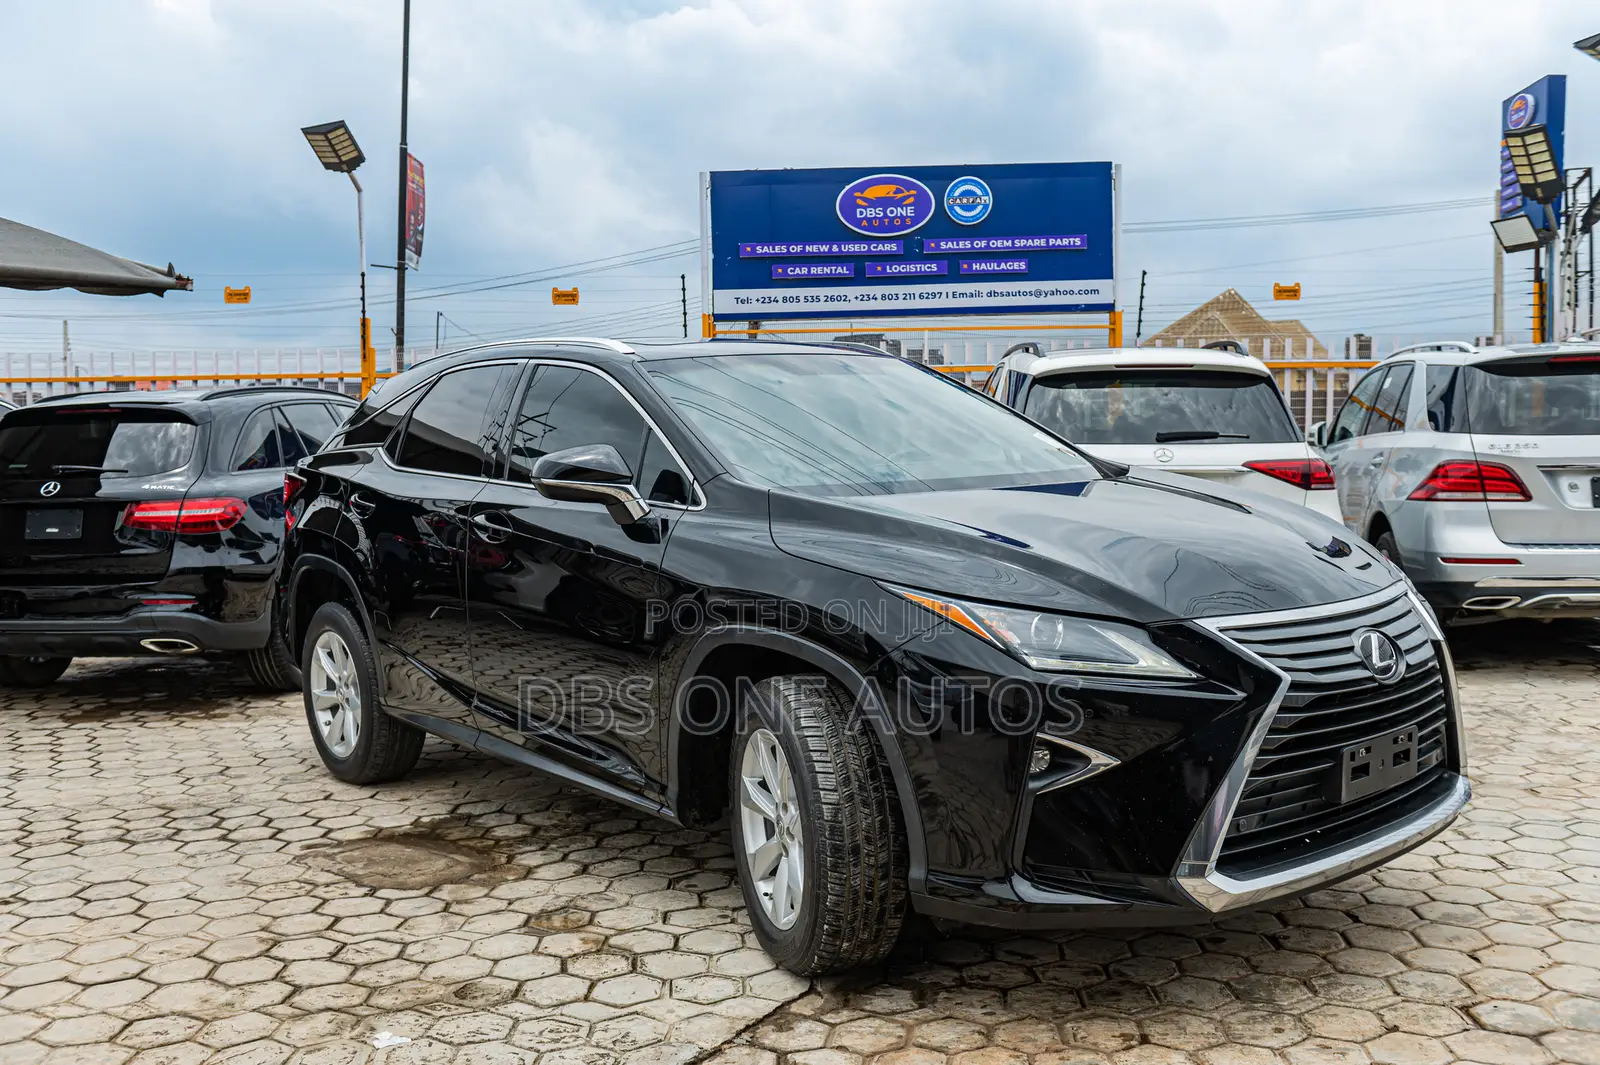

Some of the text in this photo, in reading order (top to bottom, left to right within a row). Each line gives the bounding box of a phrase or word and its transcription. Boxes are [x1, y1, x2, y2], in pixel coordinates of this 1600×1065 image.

[948, 196, 989, 205] CARFAX
[856, 206, 915, 218] DBS ONE
[861, 218, 911, 227] AUTOS
[940, 237, 1081, 249] SALES OF OEM SPARE PARTS
[756, 243, 897, 254] SALES OF NEW & USED CARS
[787, 266, 849, 275] CAR RENTAL
[886, 263, 937, 273] LOGISTICS
[972, 261, 1026, 271] HAULAGES
[734, 297, 752, 305] Tel:
[755, 296, 779, 304] +234
[781, 295, 801, 303] 805
[803, 295, 820, 303] 535
[823, 294, 851, 303] 2602,
[854, 293, 878, 302] +234
[880, 292, 900, 301] 803
[902, 292, 916, 300] 211
[918, 291, 943, 300] 6297
[951, 289, 984, 299] Email:
[986, 288, 1100, 298] dbsautos@yahoo.com
